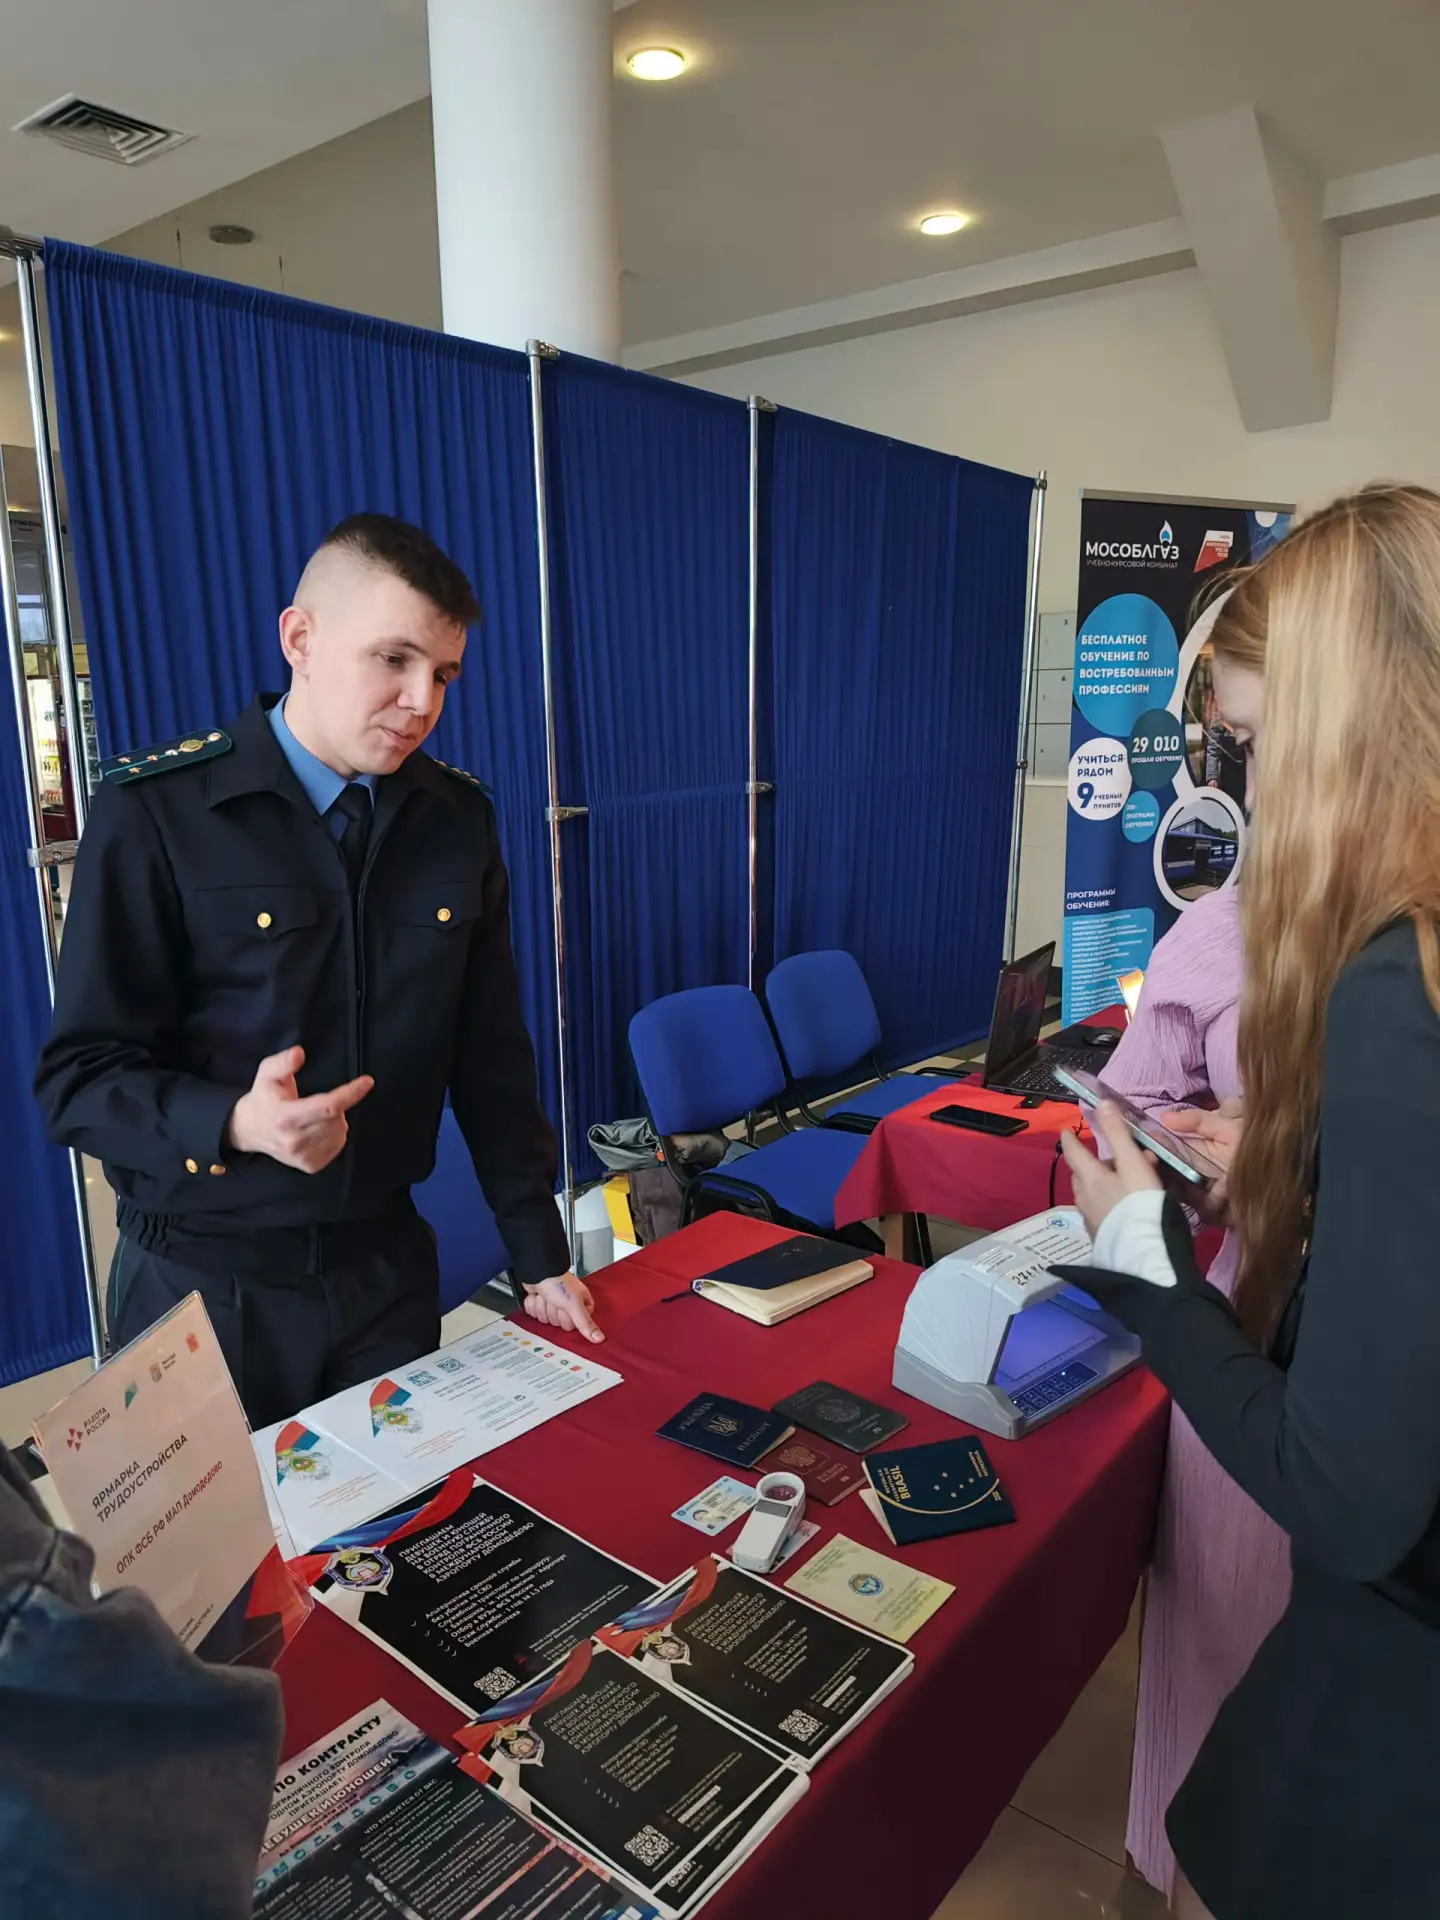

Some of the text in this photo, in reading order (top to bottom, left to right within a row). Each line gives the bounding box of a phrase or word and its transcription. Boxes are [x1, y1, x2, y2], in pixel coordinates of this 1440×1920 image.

[1081, 634, 1147, 645] БЕСПЛАТНОЕ
[1080, 651, 1150, 662] ОБУЧЕНИЕ ПО
[1079, 668, 1174, 679] ВОСТРЕБОВАННЫМ
[1078, 754, 1124, 764] УЧИТЬСЯ
[1132, 736, 1180, 753] 29 010
[1078, 767, 1113, 777] РЯДОМ
[1077, 782, 1094, 808] 9
[1066, 888, 1116, 900] ПРОГРАММЫ
[84, 1407, 105, 1429] РАБОТА
[87, 1414, 110, 1436] РОССИИ
[93, 1460, 139, 1510] ЯРМАРКА
[97, 1433, 187, 1524] ТРУДОУСТРОЙСТВА
[889, 1465, 912, 1500] BRASIL
[117, 1551, 134, 1575] ОПК
[135, 1532, 153, 1556] ФСБ
[154, 1520, 165, 1537] РФ
[166, 1502, 182, 1524] МАП
[399, 1525, 453, 1556] ПРИГЛАШАЕМ
[405, 1539, 442, 1562] ДЕВУШЕК
[450, 1513, 486, 1534] ЮНОШЕЙ
[424, 1534, 463, 1558] ВОЕННУЮ
[463, 1516, 494, 1534] СЛУЖБУ
[424, 1550, 450, 1565] ОТРЯД
[450, 1514, 510, 1550] ПОГРАНИЧНОГО
[424, 1520, 514, 1573] КОНТРОЛЯ ФСБ РОССИИ
[435, 1522, 534, 1583] АЭРОПОРТУ ДОМОДЕДОВО
[436, 1531, 508, 1573] МЕЖДУНАРОДНОМ
[272, 1716, 383, 1793] ПО КОНТРАКТУ
[271, 1741, 370, 1810] ОГРАНИЧНОГО КОНТРОЛЯ
[301, 1767, 346, 1799] АЭРОПОРТУ
